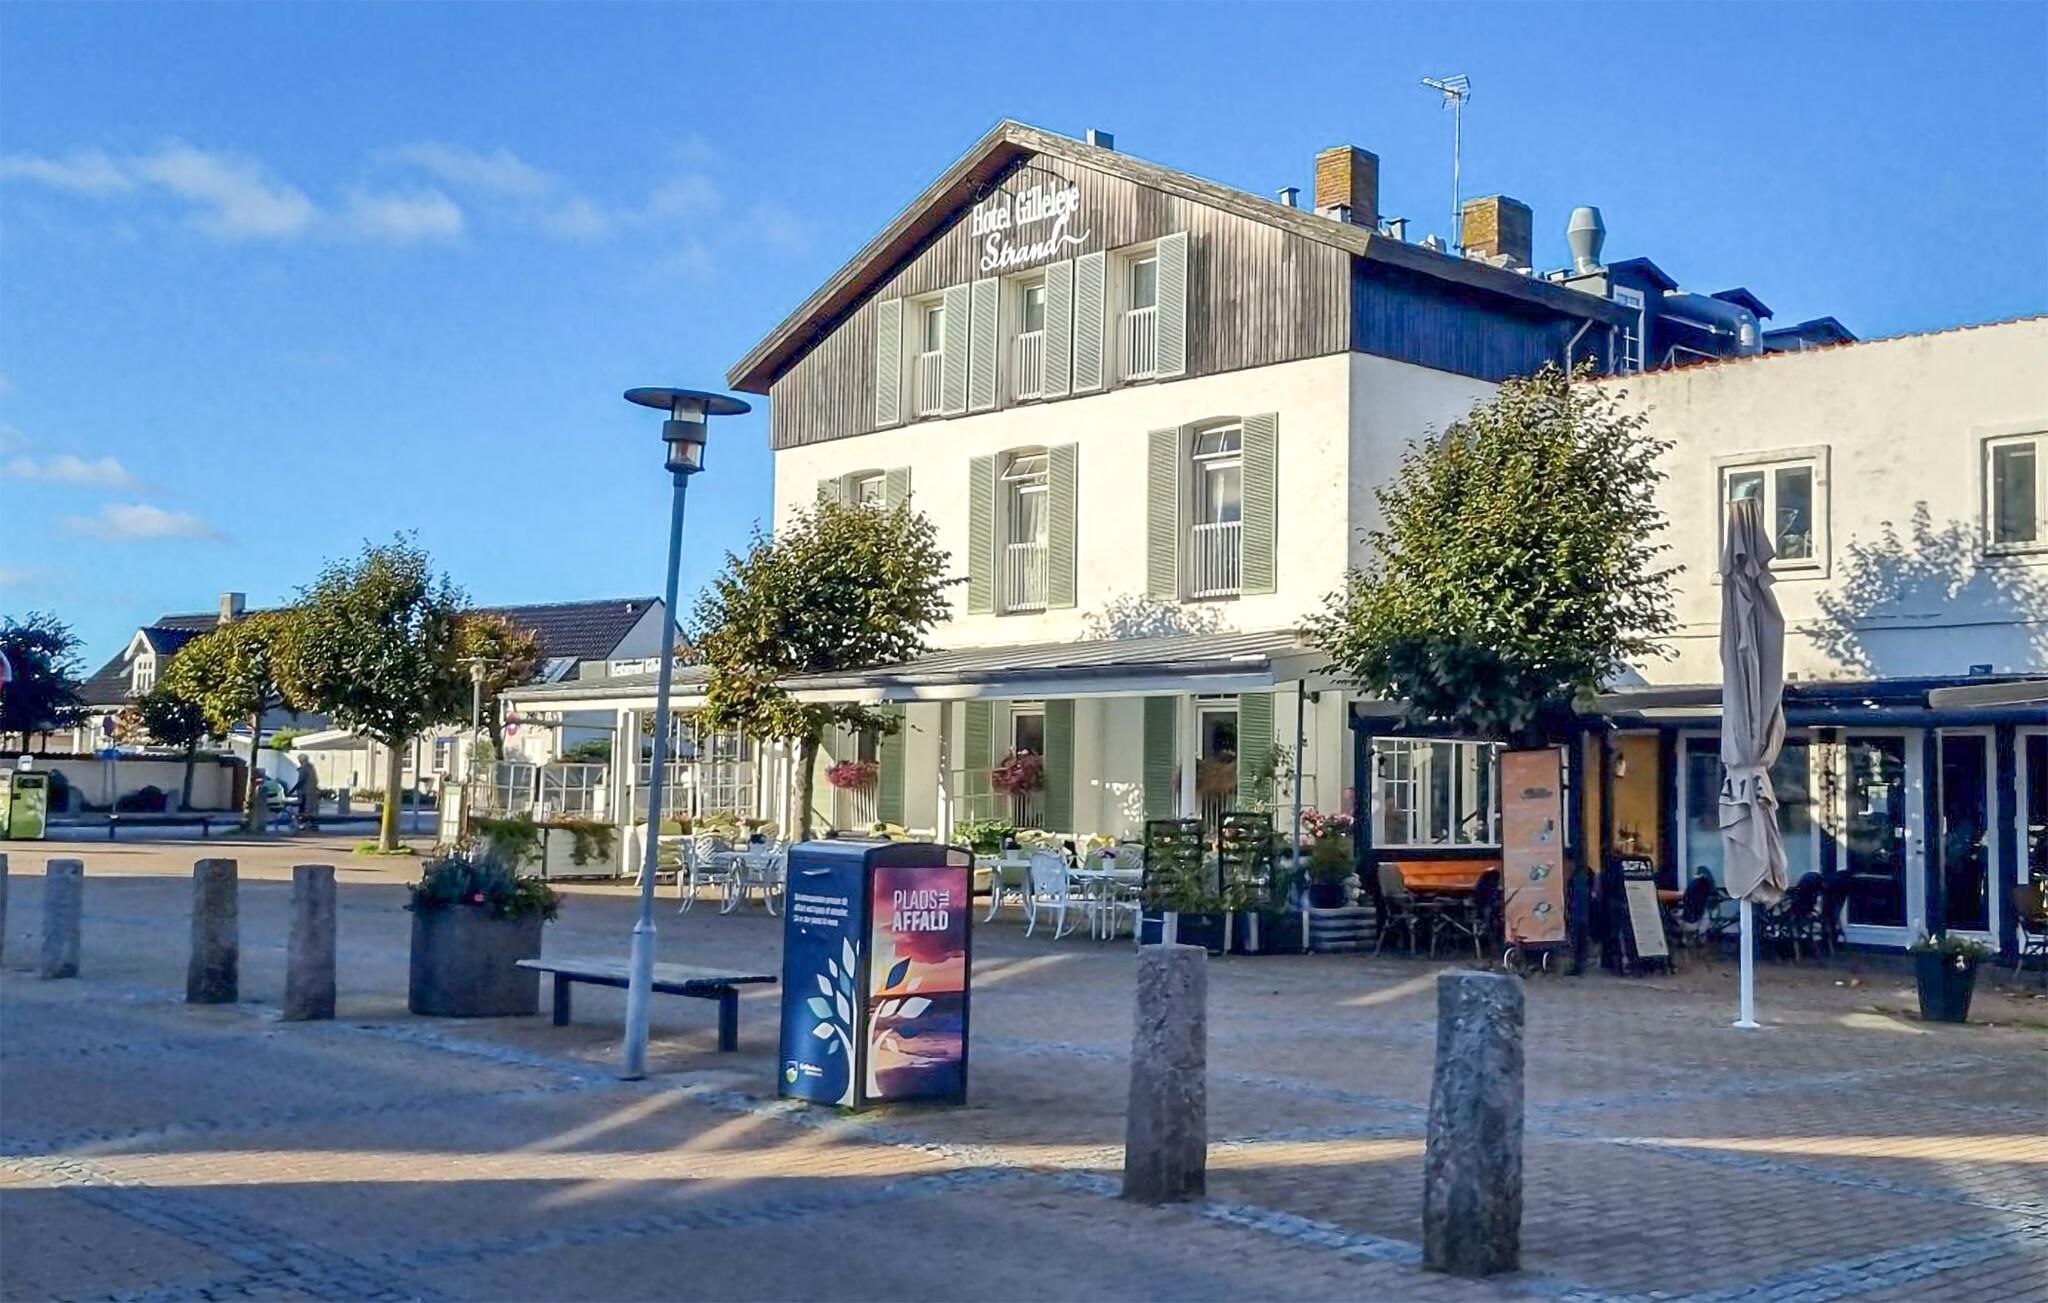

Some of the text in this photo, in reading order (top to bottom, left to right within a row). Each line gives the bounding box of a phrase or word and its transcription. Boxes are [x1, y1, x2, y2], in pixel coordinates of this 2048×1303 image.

[972, 194, 1011, 237] Hotel
[980, 214, 1091, 271] Strand
[894, 889, 938, 910] PLADS
[892, 910, 949, 931] AFFALD
